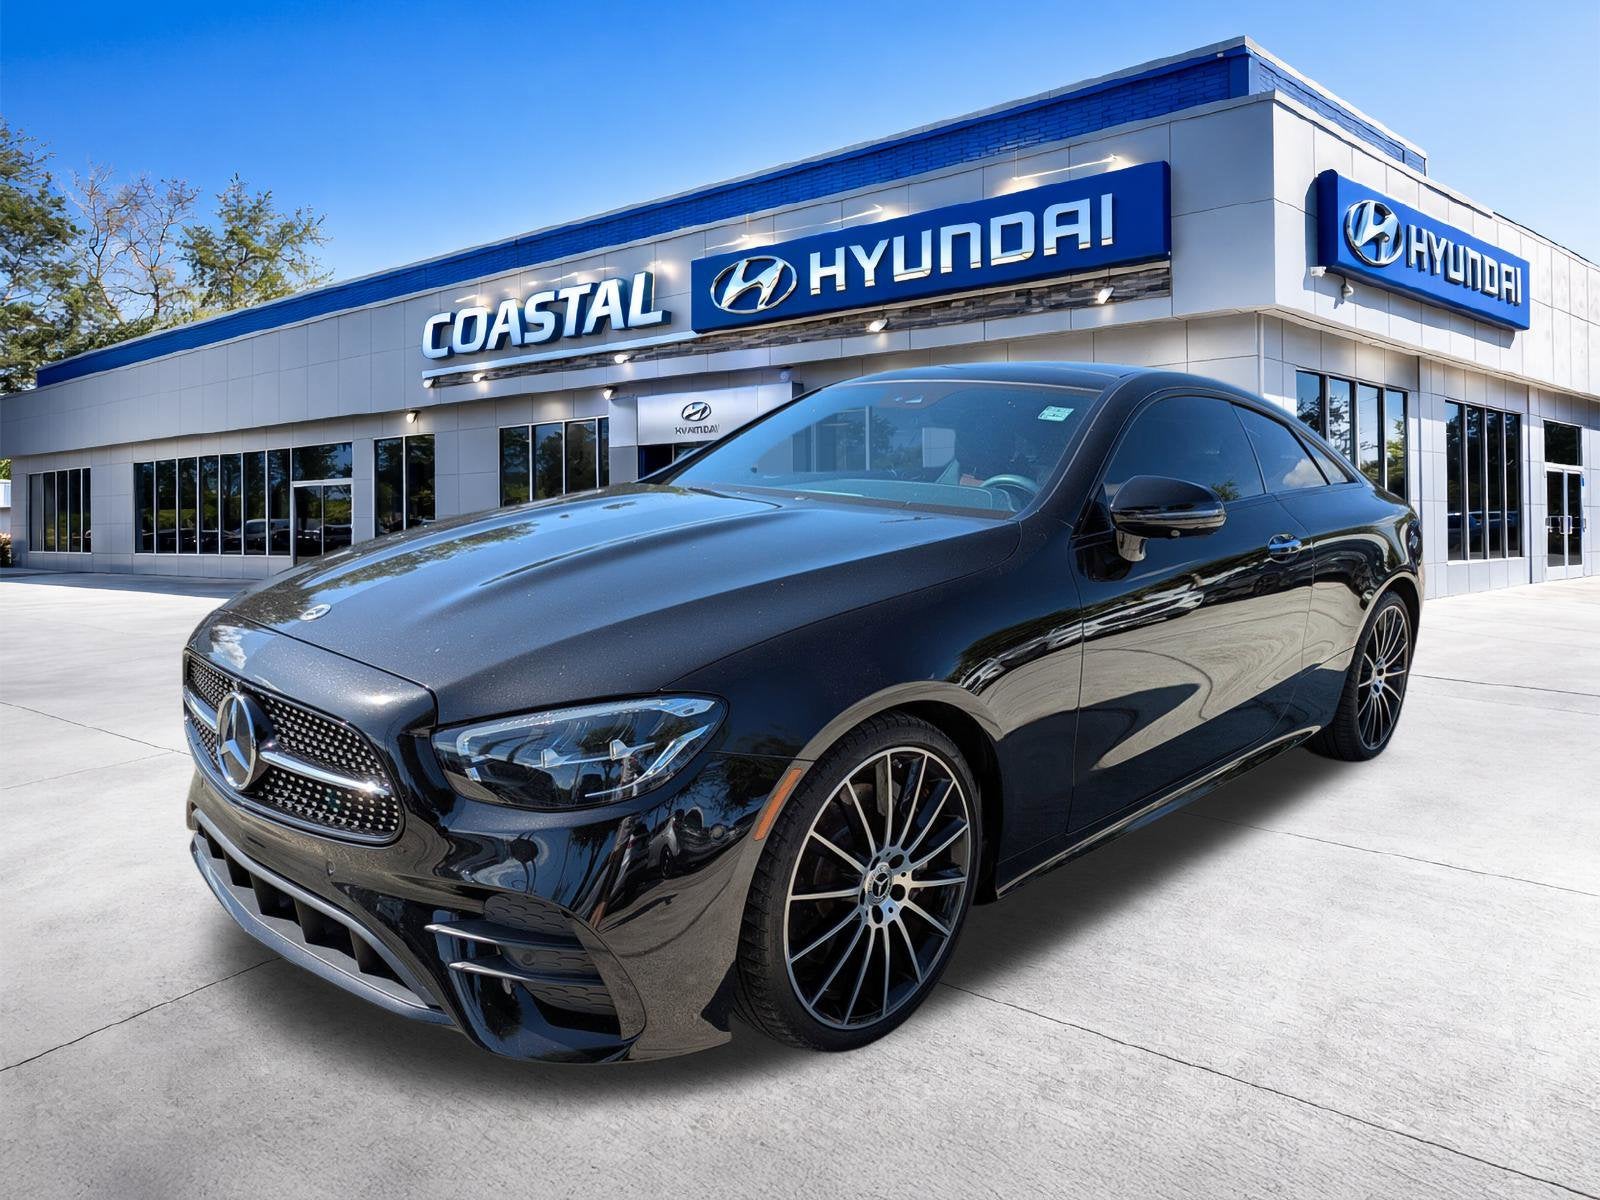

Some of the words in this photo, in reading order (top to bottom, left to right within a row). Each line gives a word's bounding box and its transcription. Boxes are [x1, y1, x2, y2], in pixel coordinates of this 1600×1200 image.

[809, 193, 1113, 295] HYUNDAI
[1406, 224, 1522, 306] HYUNDAI
[422, 271, 670, 359] COASTAL
